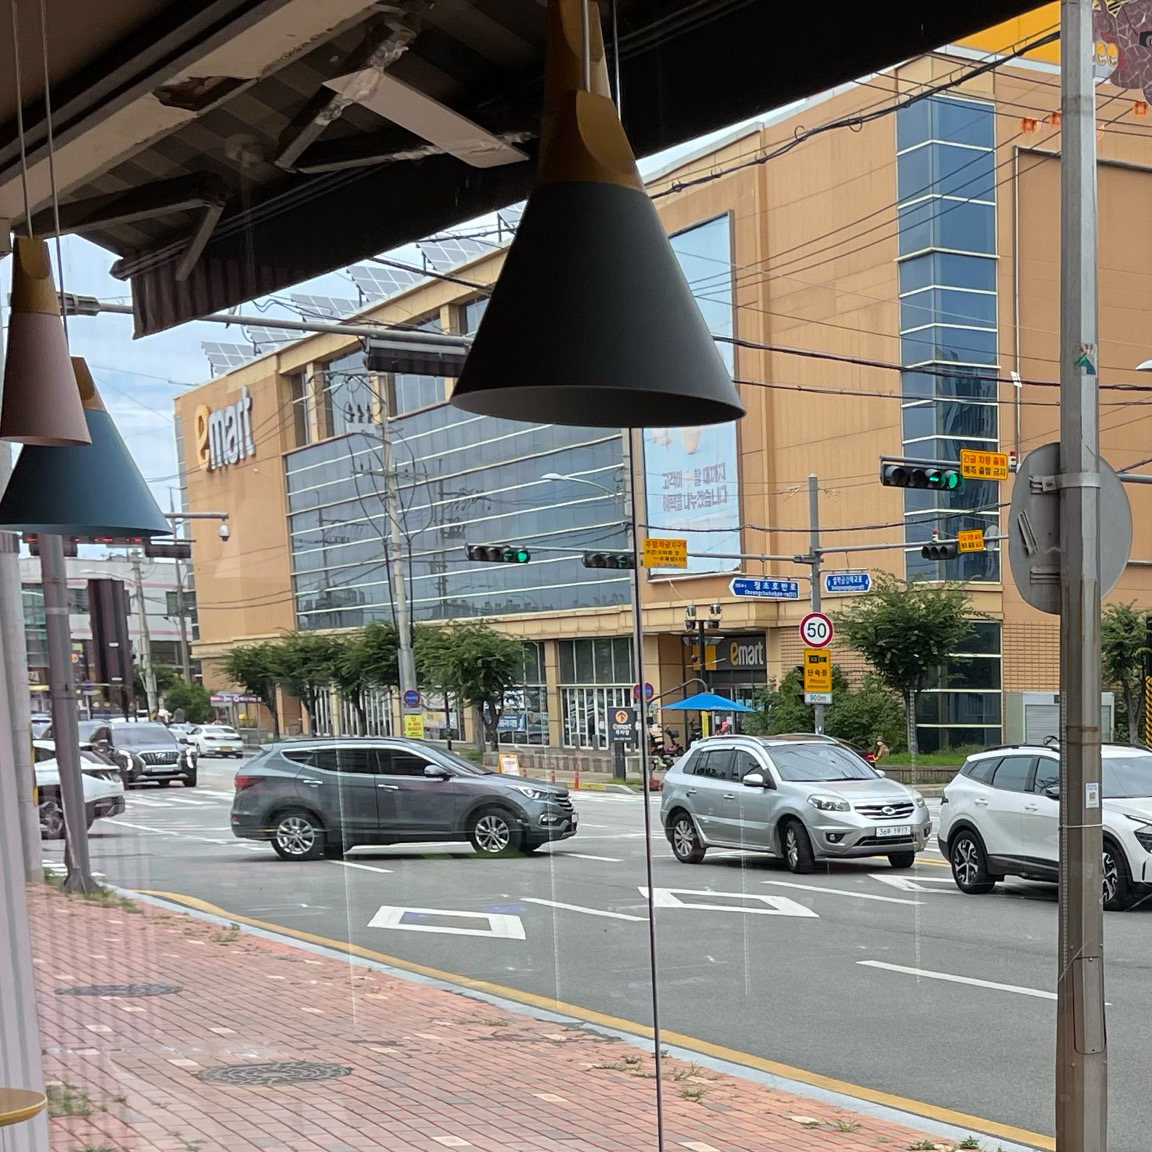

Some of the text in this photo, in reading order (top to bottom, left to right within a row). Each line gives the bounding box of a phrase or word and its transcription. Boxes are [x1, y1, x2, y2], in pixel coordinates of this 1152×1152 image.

[194, 385, 254, 469] emart
[963, 454, 976, 464] 긴급
[993, 467, 1006, 477] 금지
[754, 581, 797, 592] 청초호반로
[807, 622, 827, 638] 50
[730, 641, 764, 666] emart
[807, 669, 828, 677] 단속중
